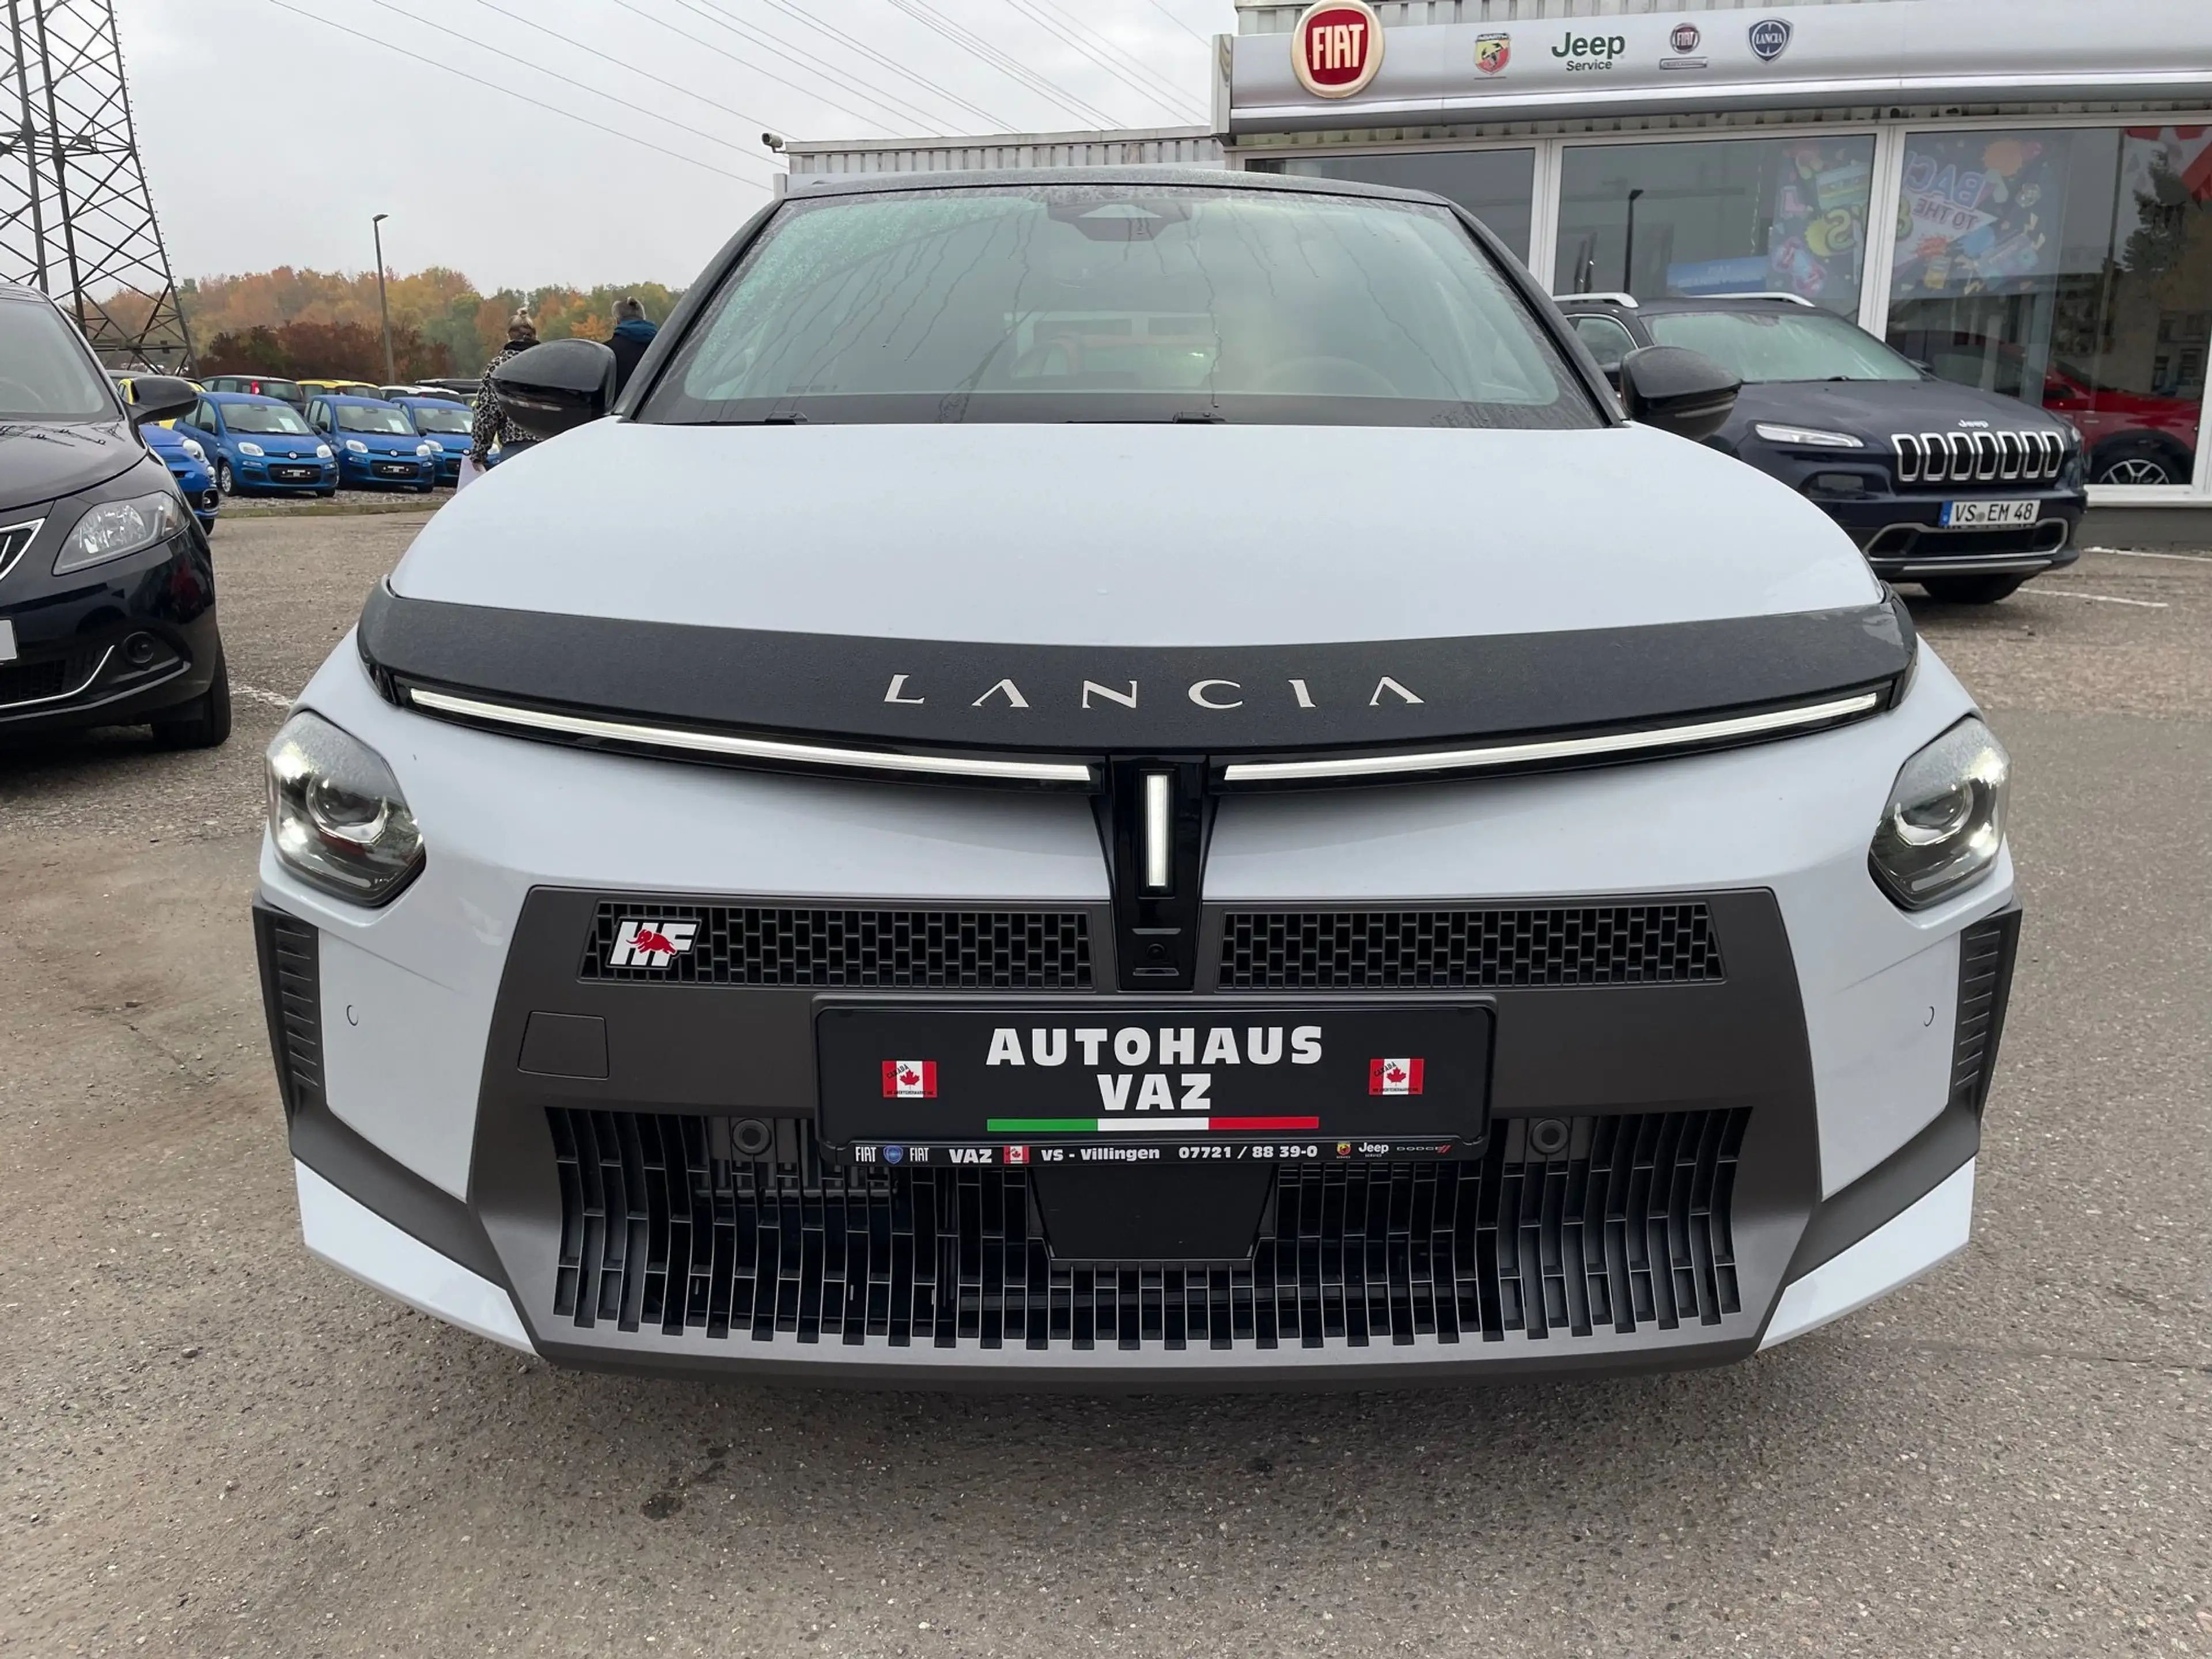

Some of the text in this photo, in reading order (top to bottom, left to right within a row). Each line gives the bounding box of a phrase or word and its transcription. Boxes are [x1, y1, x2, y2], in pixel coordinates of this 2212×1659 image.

[1312, 24, 1364, 70] FIAT
[1551, 32, 1625, 59] Jeep
[1676, 31, 1695, 47] FIAT
[1756, 33, 1782, 44] LANCIA
[1566, 59, 1612, 71] Service
[1955, 502, 2033, 521] VS EM 48
[884, 673, 1425, 709] LANCIA
[609, 922, 697, 967] HF
[986, 1026, 1323, 1066] AUTOHAUS
[1097, 1073, 1211, 1111] VAZ
[855, 1146, 876, 1162] FIAT
[910, 1147, 929, 1162] FIAT
[949, 1149, 993, 1164] VAZ
[1041, 1149, 1063, 1161] VS
[1080, 1147, 1160, 1161] Villingen
[1179, 1146, 1231, 1158] 07721
[1252, 1146, 1274, 1158] 88
[1279, 1145, 1318, 1157] 39-0
[1358, 1142, 1389, 1154] Jeep
